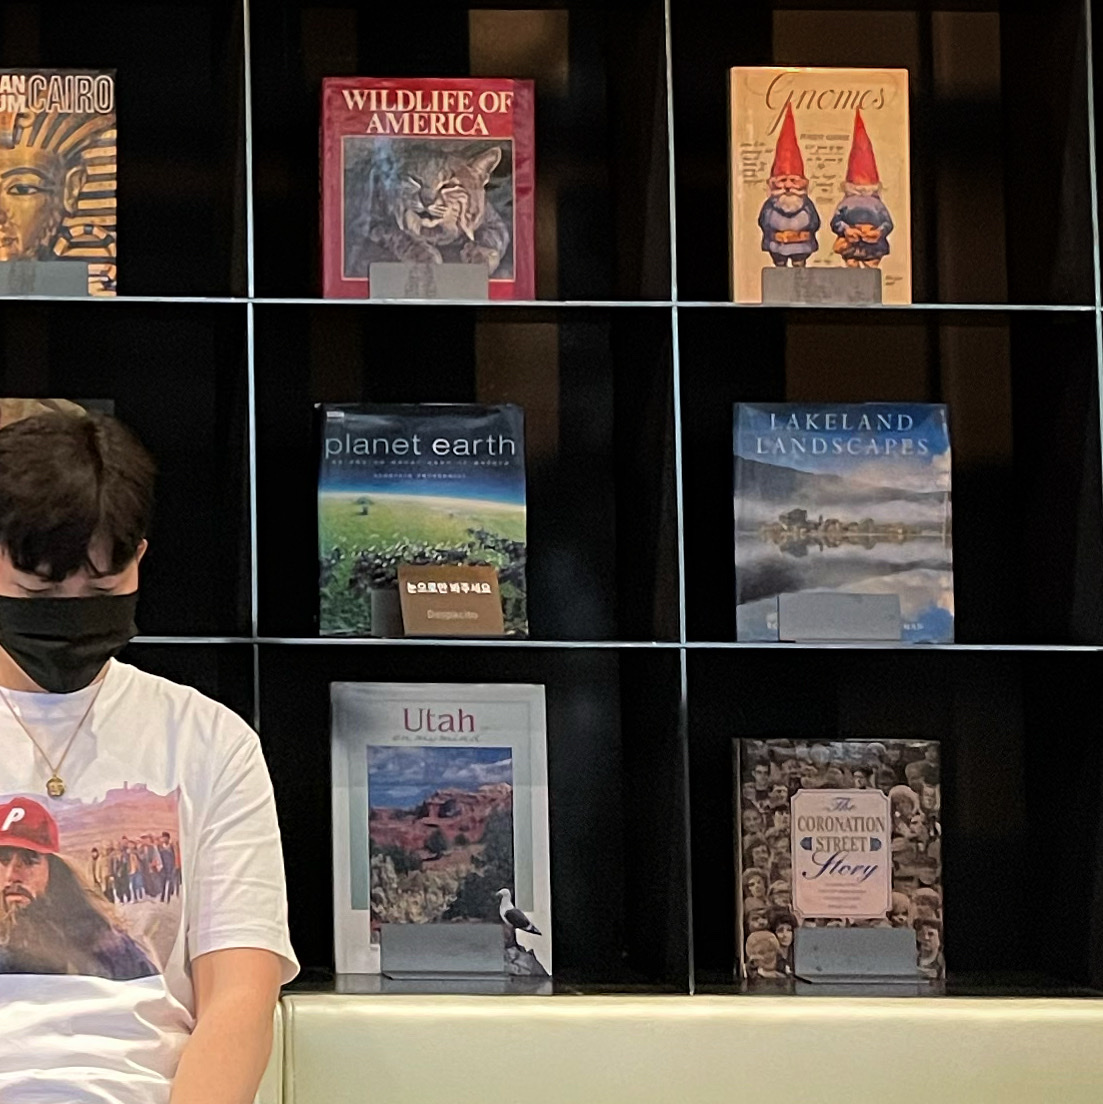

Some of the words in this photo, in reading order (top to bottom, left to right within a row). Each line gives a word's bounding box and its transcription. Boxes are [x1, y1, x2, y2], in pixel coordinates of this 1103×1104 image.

[28, 75, 114, 113] CAIRO
[341, 89, 474, 113] WILDLIFE
[479, 91, 514, 114] OF
[764, 71, 886, 136] Gnomes
[366, 113, 490, 136] AMERICA
[769, 412, 914, 431] LAKELAND
[325, 433, 422, 459] planet
[432, 434, 516, 457] earth
[756, 437, 930, 455] LANDSCAPES
[403, 708, 475, 733] Utah
[826, 797, 856, 812] The
[1, 807, 26, 832] P
[797, 815, 885, 832] CORONATION
[815, 835, 868, 852] STREET
[801, 850, 879, 882] Story
